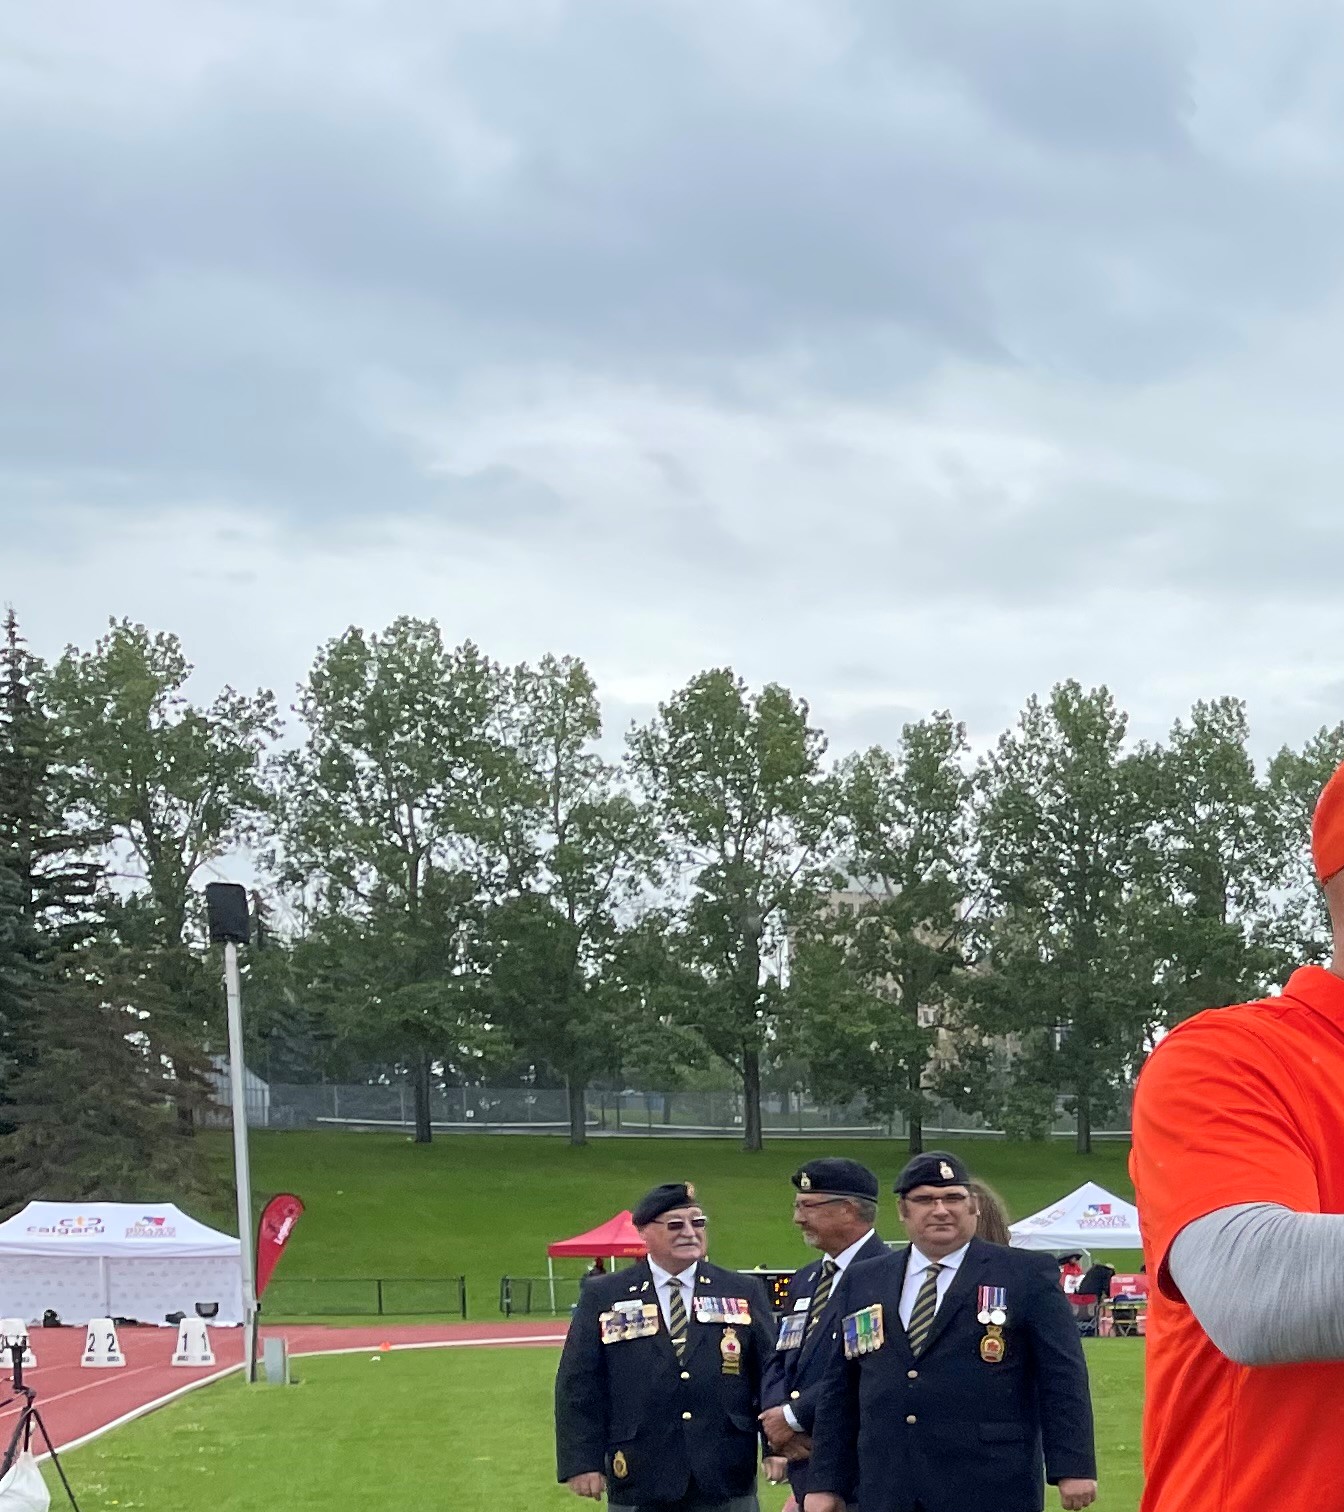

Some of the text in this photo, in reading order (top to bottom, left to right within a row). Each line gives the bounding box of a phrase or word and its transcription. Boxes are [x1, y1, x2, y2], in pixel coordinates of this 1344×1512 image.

[87, 1332, 96, 1353] 2
[106, 1332, 117, 1353] 2
[181, 1332, 188, 1352] 1
[200, 1332, 208, 1352] 1
